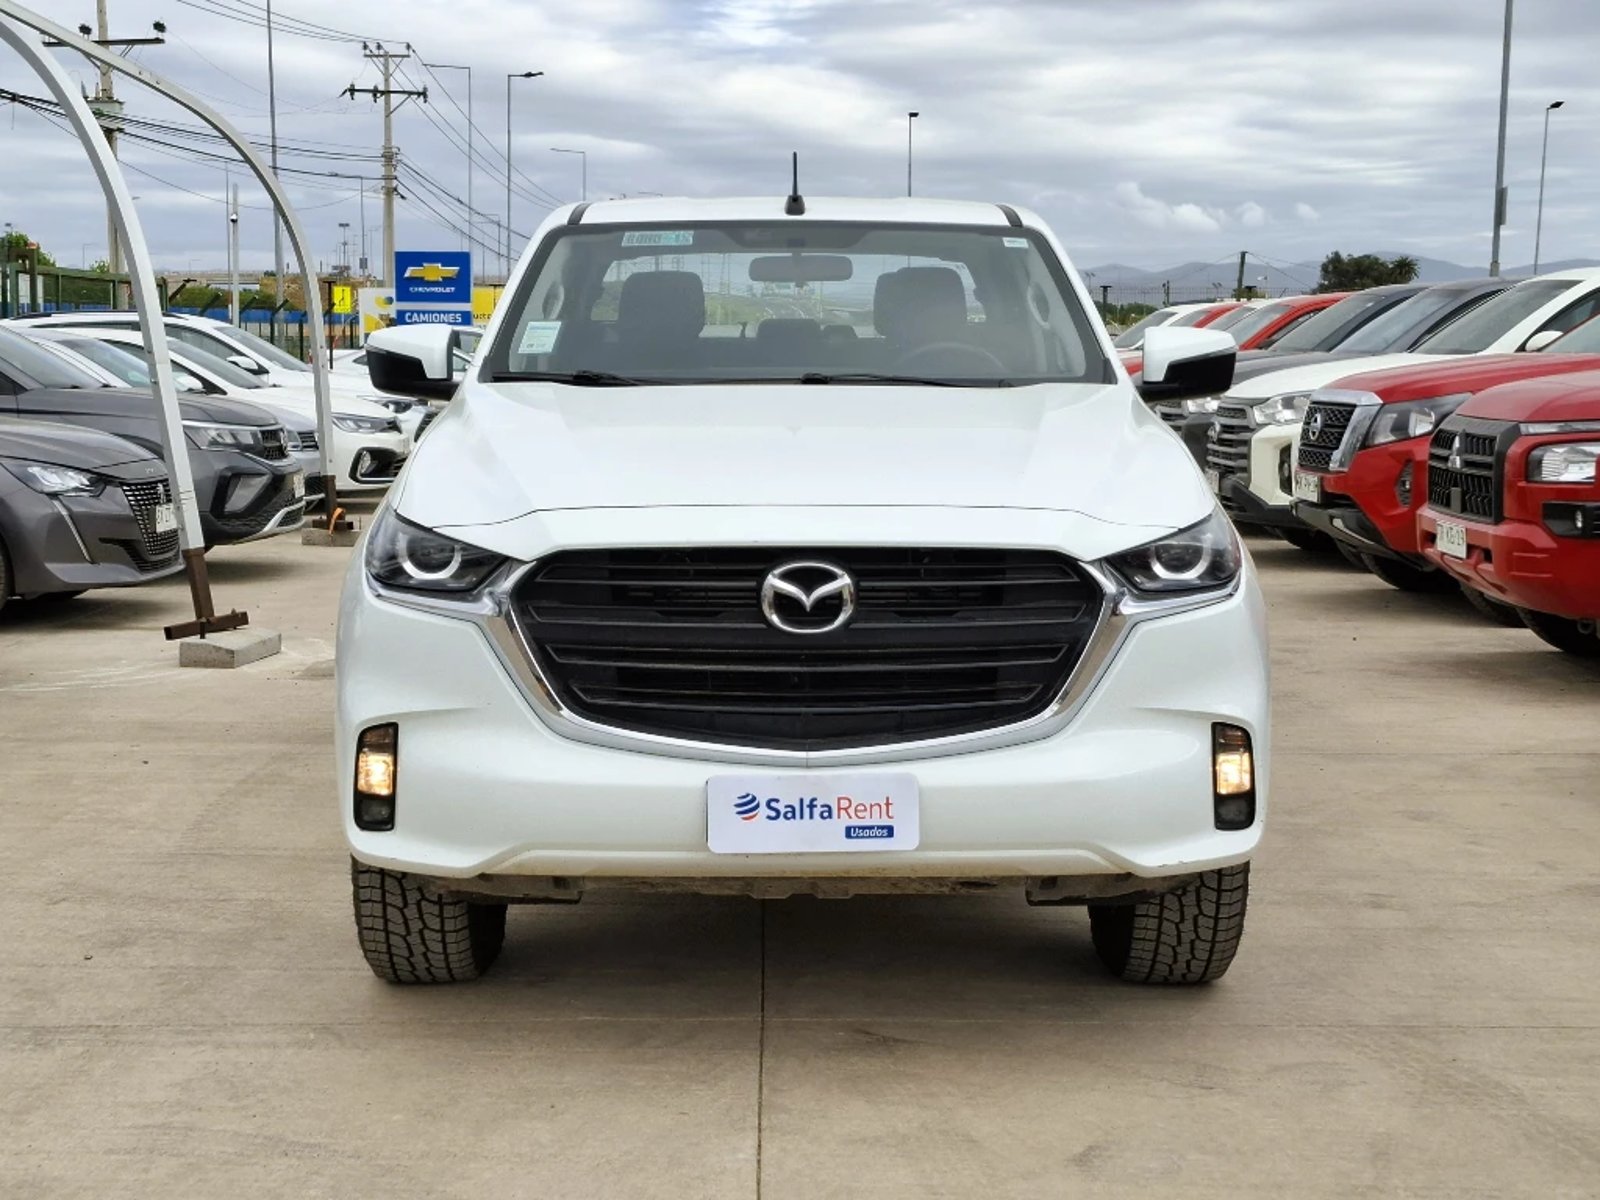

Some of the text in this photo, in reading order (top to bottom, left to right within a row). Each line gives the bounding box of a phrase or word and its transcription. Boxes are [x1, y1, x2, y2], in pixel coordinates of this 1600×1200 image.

[404, 312, 462, 323] CAMIONES
[765, 796, 894, 821] SalfaRent
[850, 826, 889, 838] Usados
